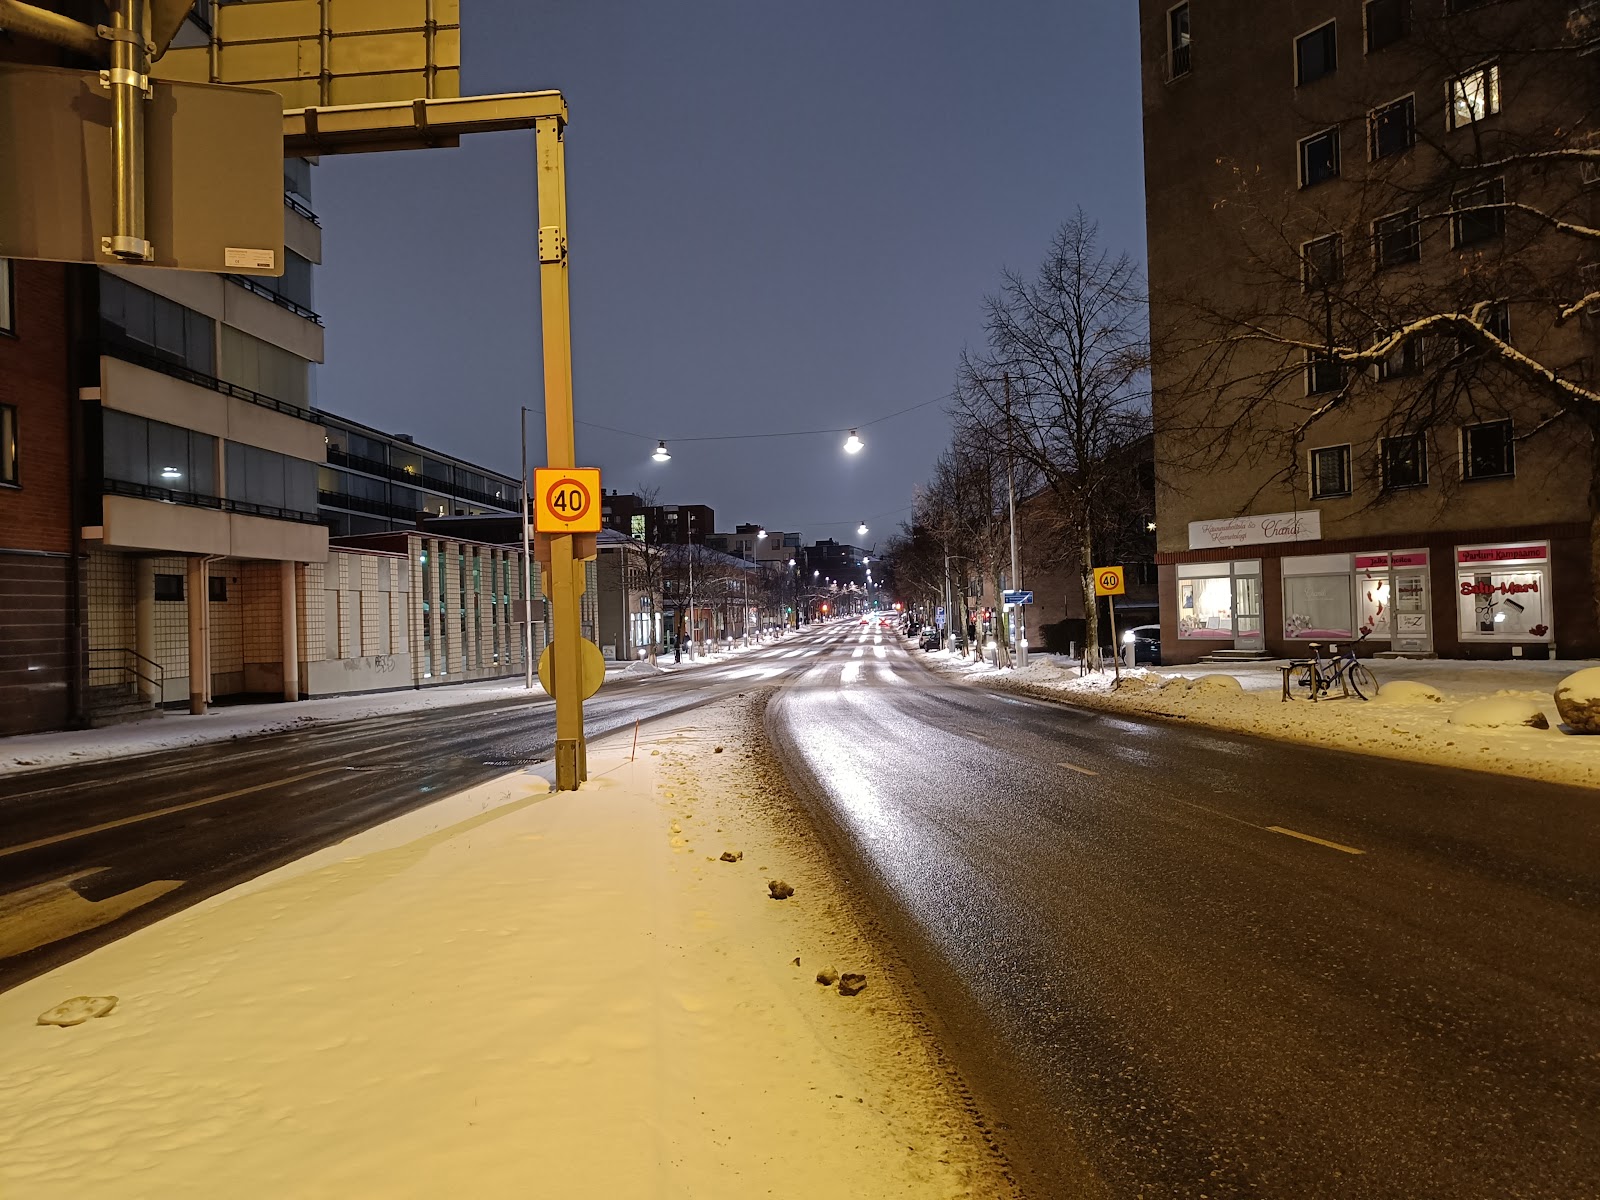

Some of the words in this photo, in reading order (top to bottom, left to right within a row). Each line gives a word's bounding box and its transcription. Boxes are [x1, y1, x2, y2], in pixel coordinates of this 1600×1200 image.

[554, 490, 581, 511] 40
[1463, 550, 1493, 562] Parturi
[1496, 549, 1540, 560] Kampaamo
[1103, 576, 1115, 586] 40
[1460, 580, 1538, 595] Satu-Mari
[937, 606, 944, 615] P
